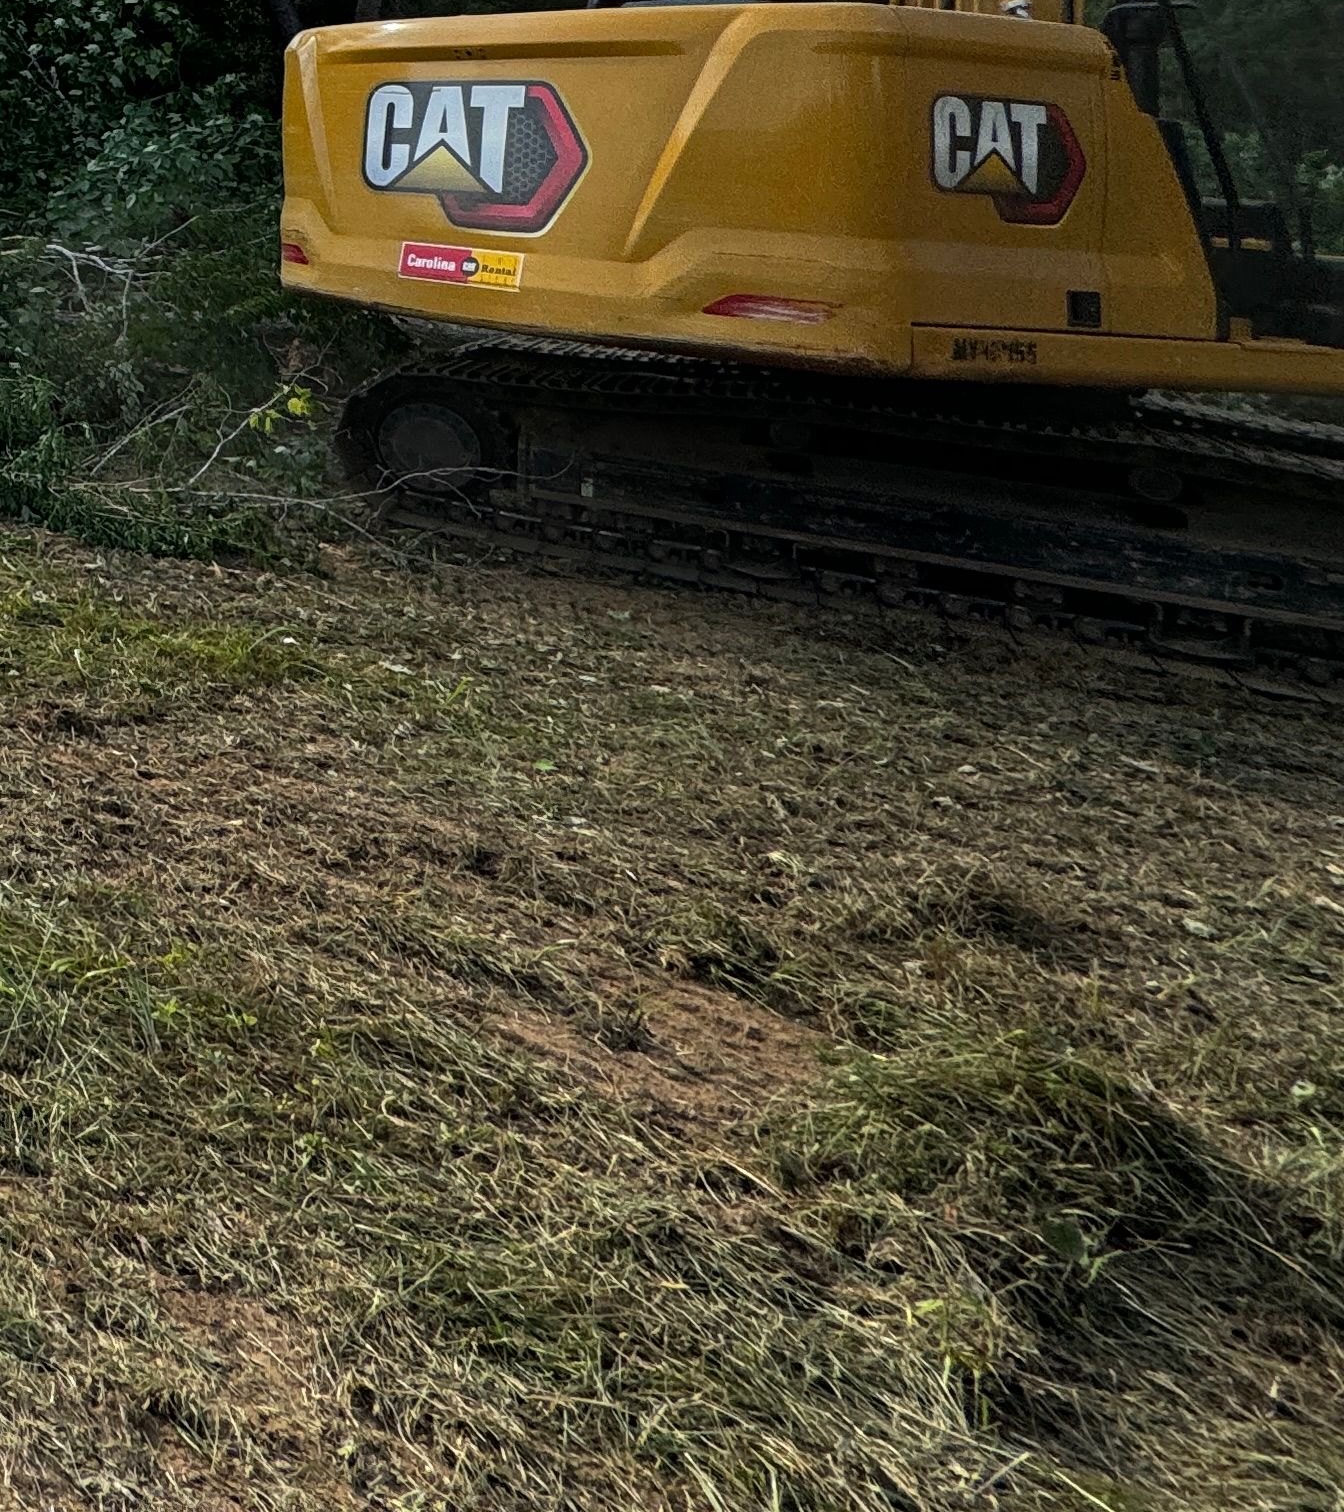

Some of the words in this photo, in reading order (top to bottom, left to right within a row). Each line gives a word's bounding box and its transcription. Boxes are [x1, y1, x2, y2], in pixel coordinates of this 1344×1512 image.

[366, 85, 525, 194] CAT
[933, 96, 1047, 194] CAT
[407, 253, 456, 272] Carolina
[480, 264, 517, 277] Rental
